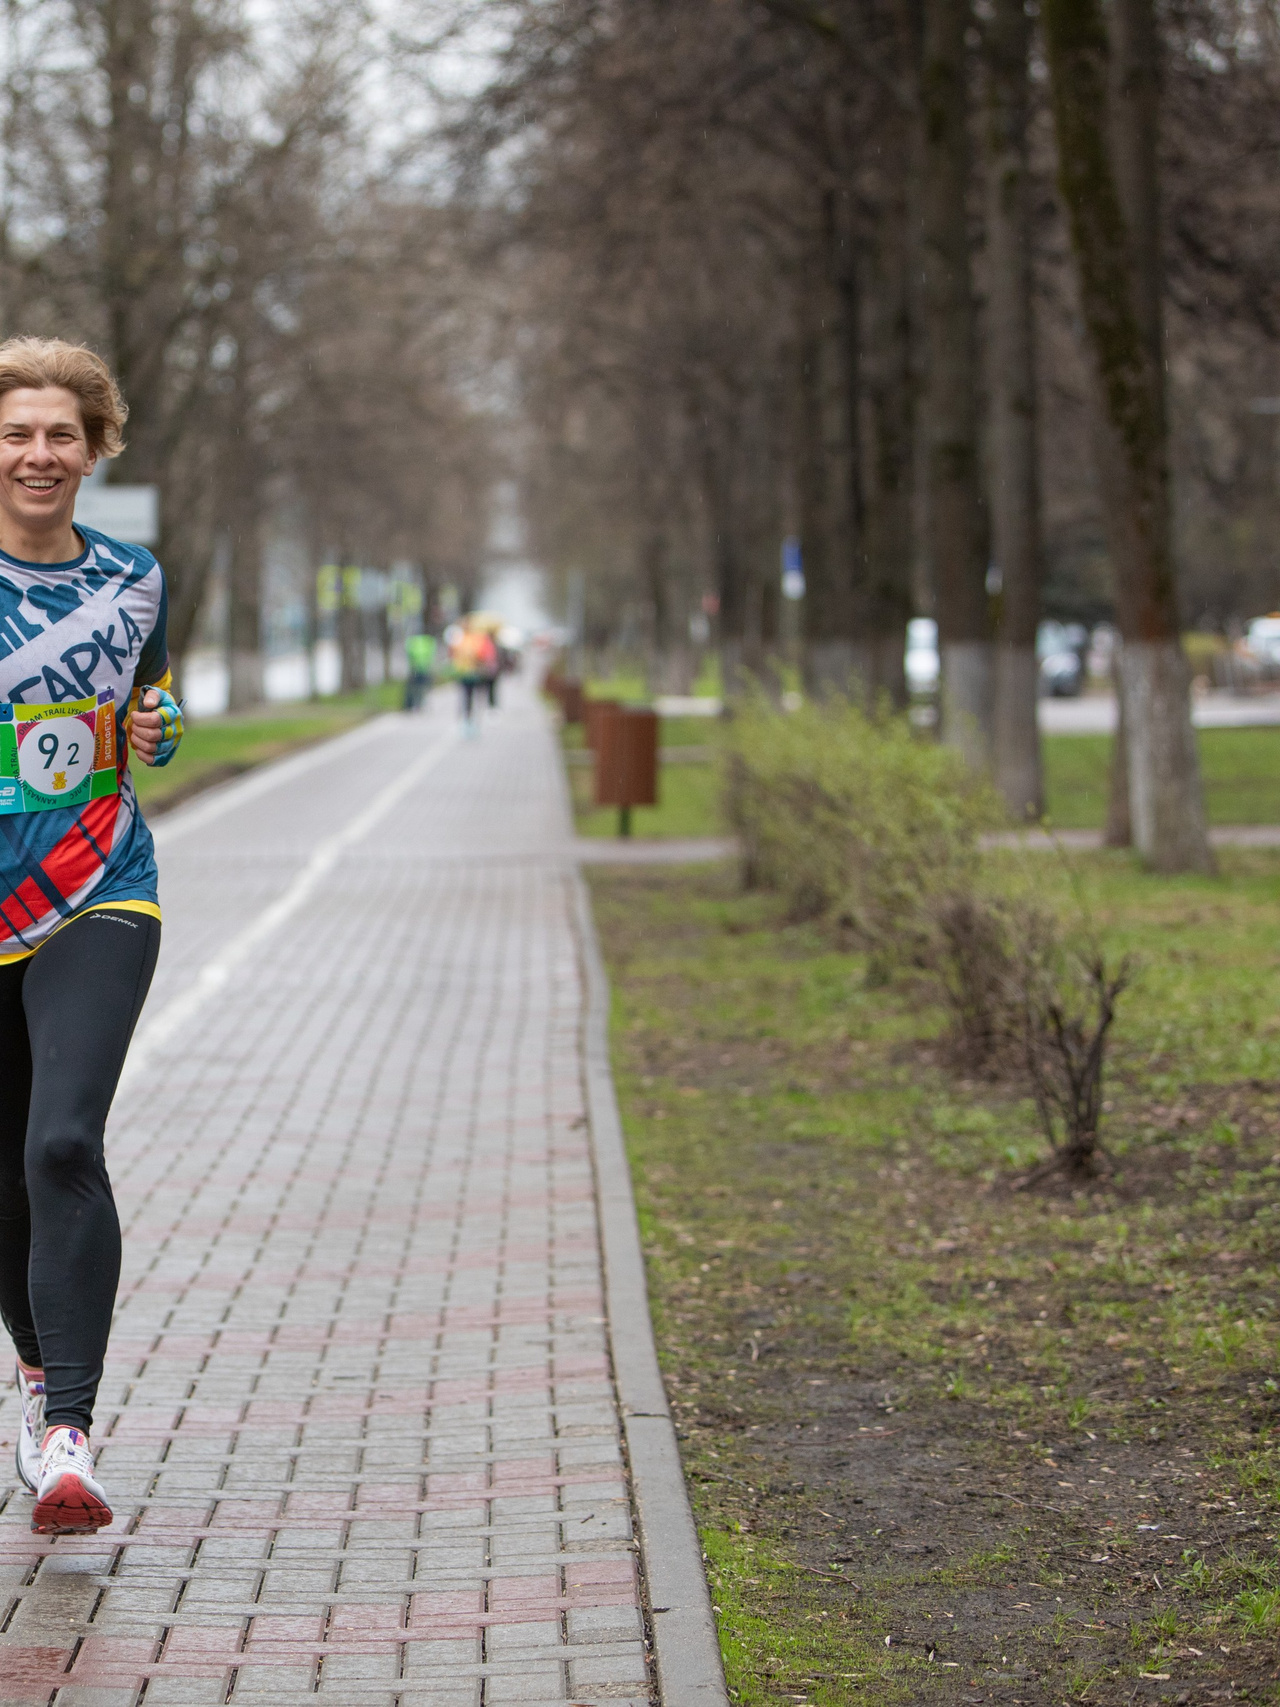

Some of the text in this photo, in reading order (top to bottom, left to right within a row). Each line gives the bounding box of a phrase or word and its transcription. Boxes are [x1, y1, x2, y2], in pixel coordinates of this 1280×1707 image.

[18, 707, 93, 735] DREAM TRAIL LYSKOVO
[11, 746, 19, 768] TRAIL
[38, 733, 80, 769] 9 2
[26, 789, 58, 805] KANNAS
[101, 914, 139, 929] DEMIX
